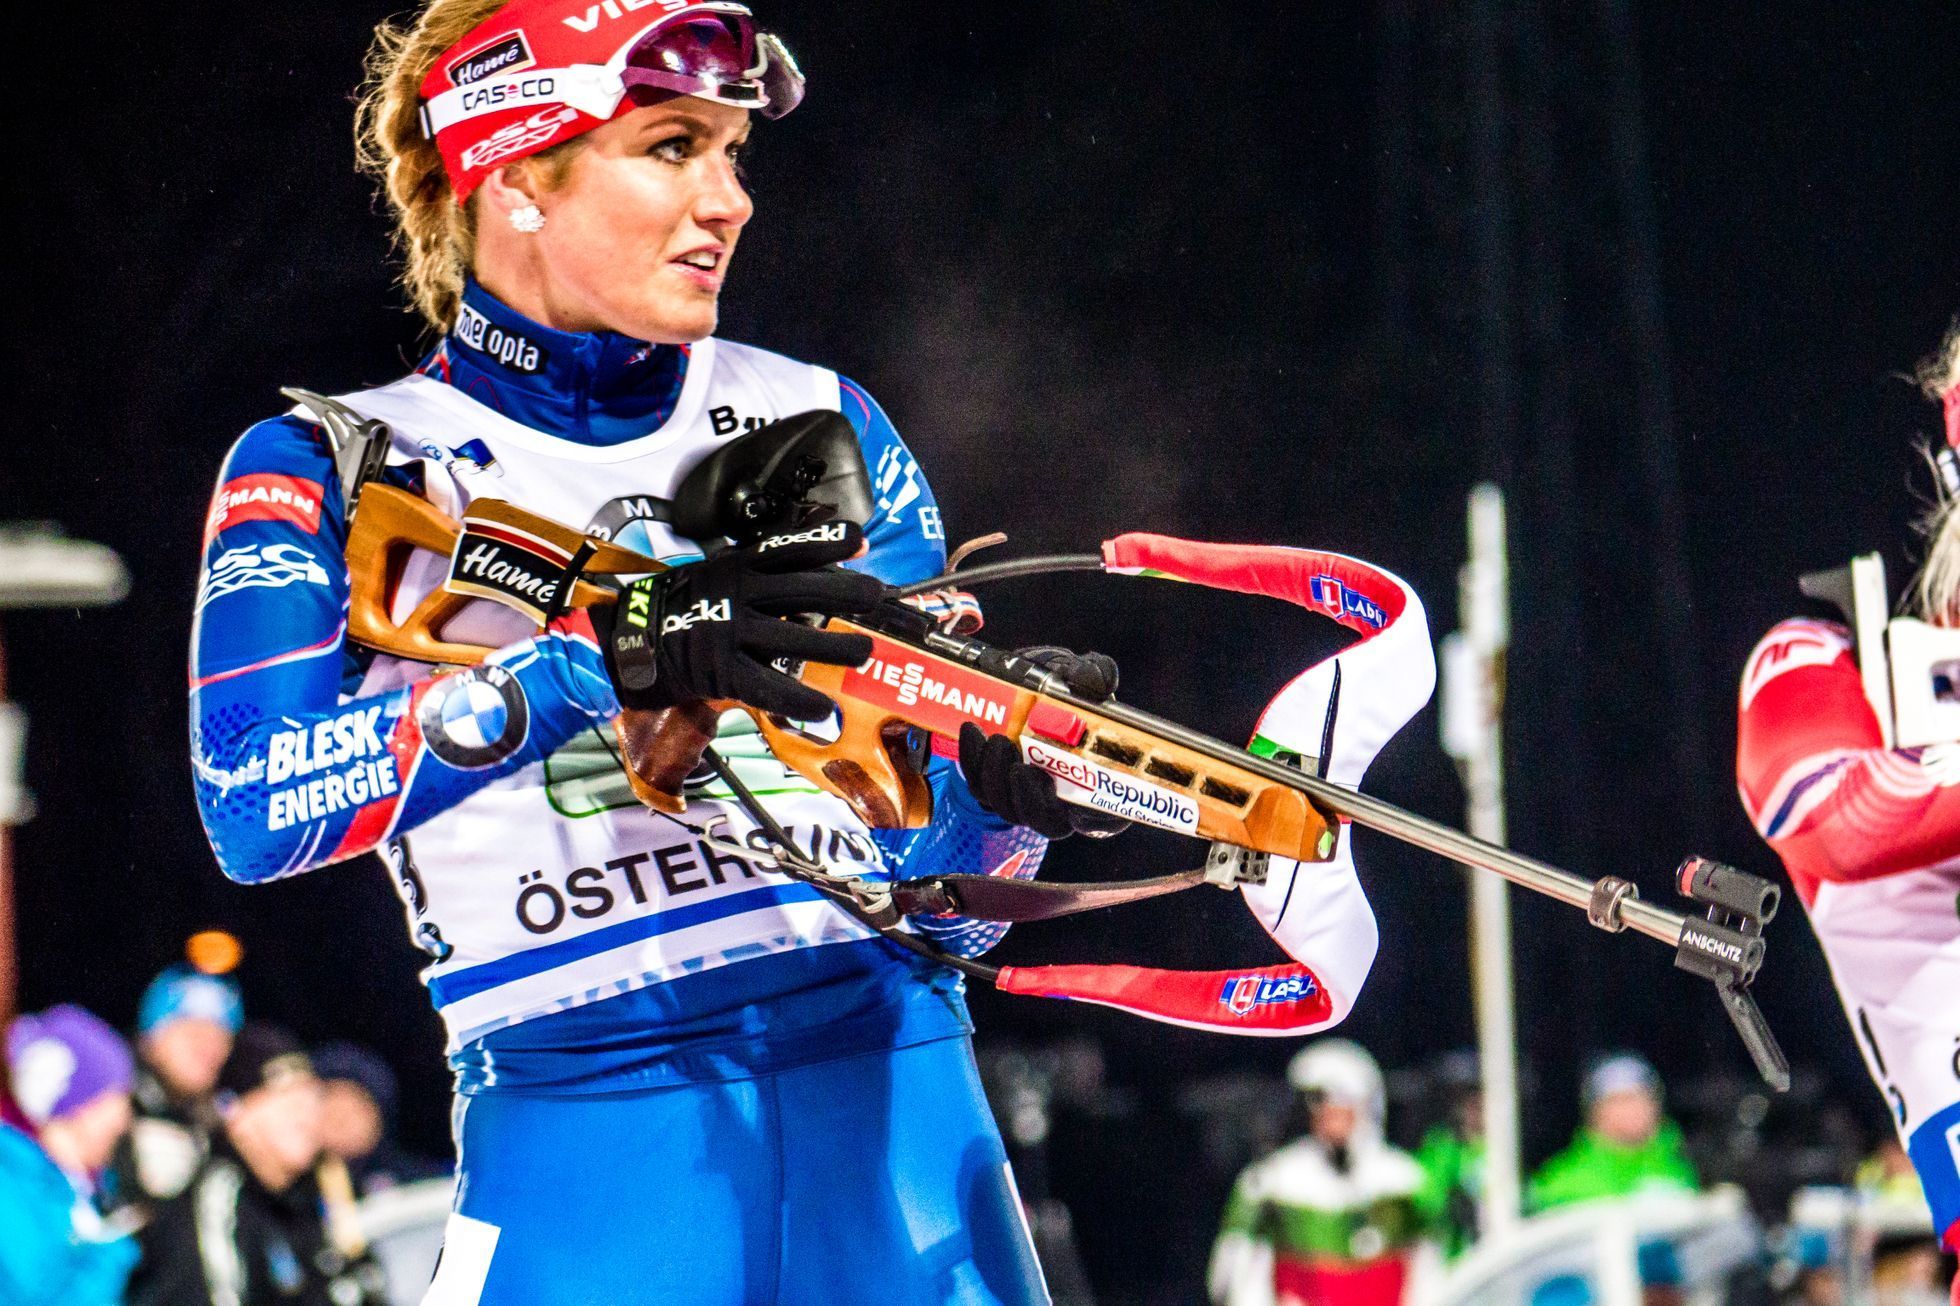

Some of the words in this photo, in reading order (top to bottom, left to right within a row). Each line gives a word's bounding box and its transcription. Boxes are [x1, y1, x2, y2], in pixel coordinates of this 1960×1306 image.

[463, 543, 560, 603] Hamé
[661, 598, 731, 636] oeckl
[267, 705, 383, 785] BLESK
[268, 756, 398, 831] ENERGIE
[1090, 792, 1120, 812] Land
[1120, 807, 1133, 817] of
